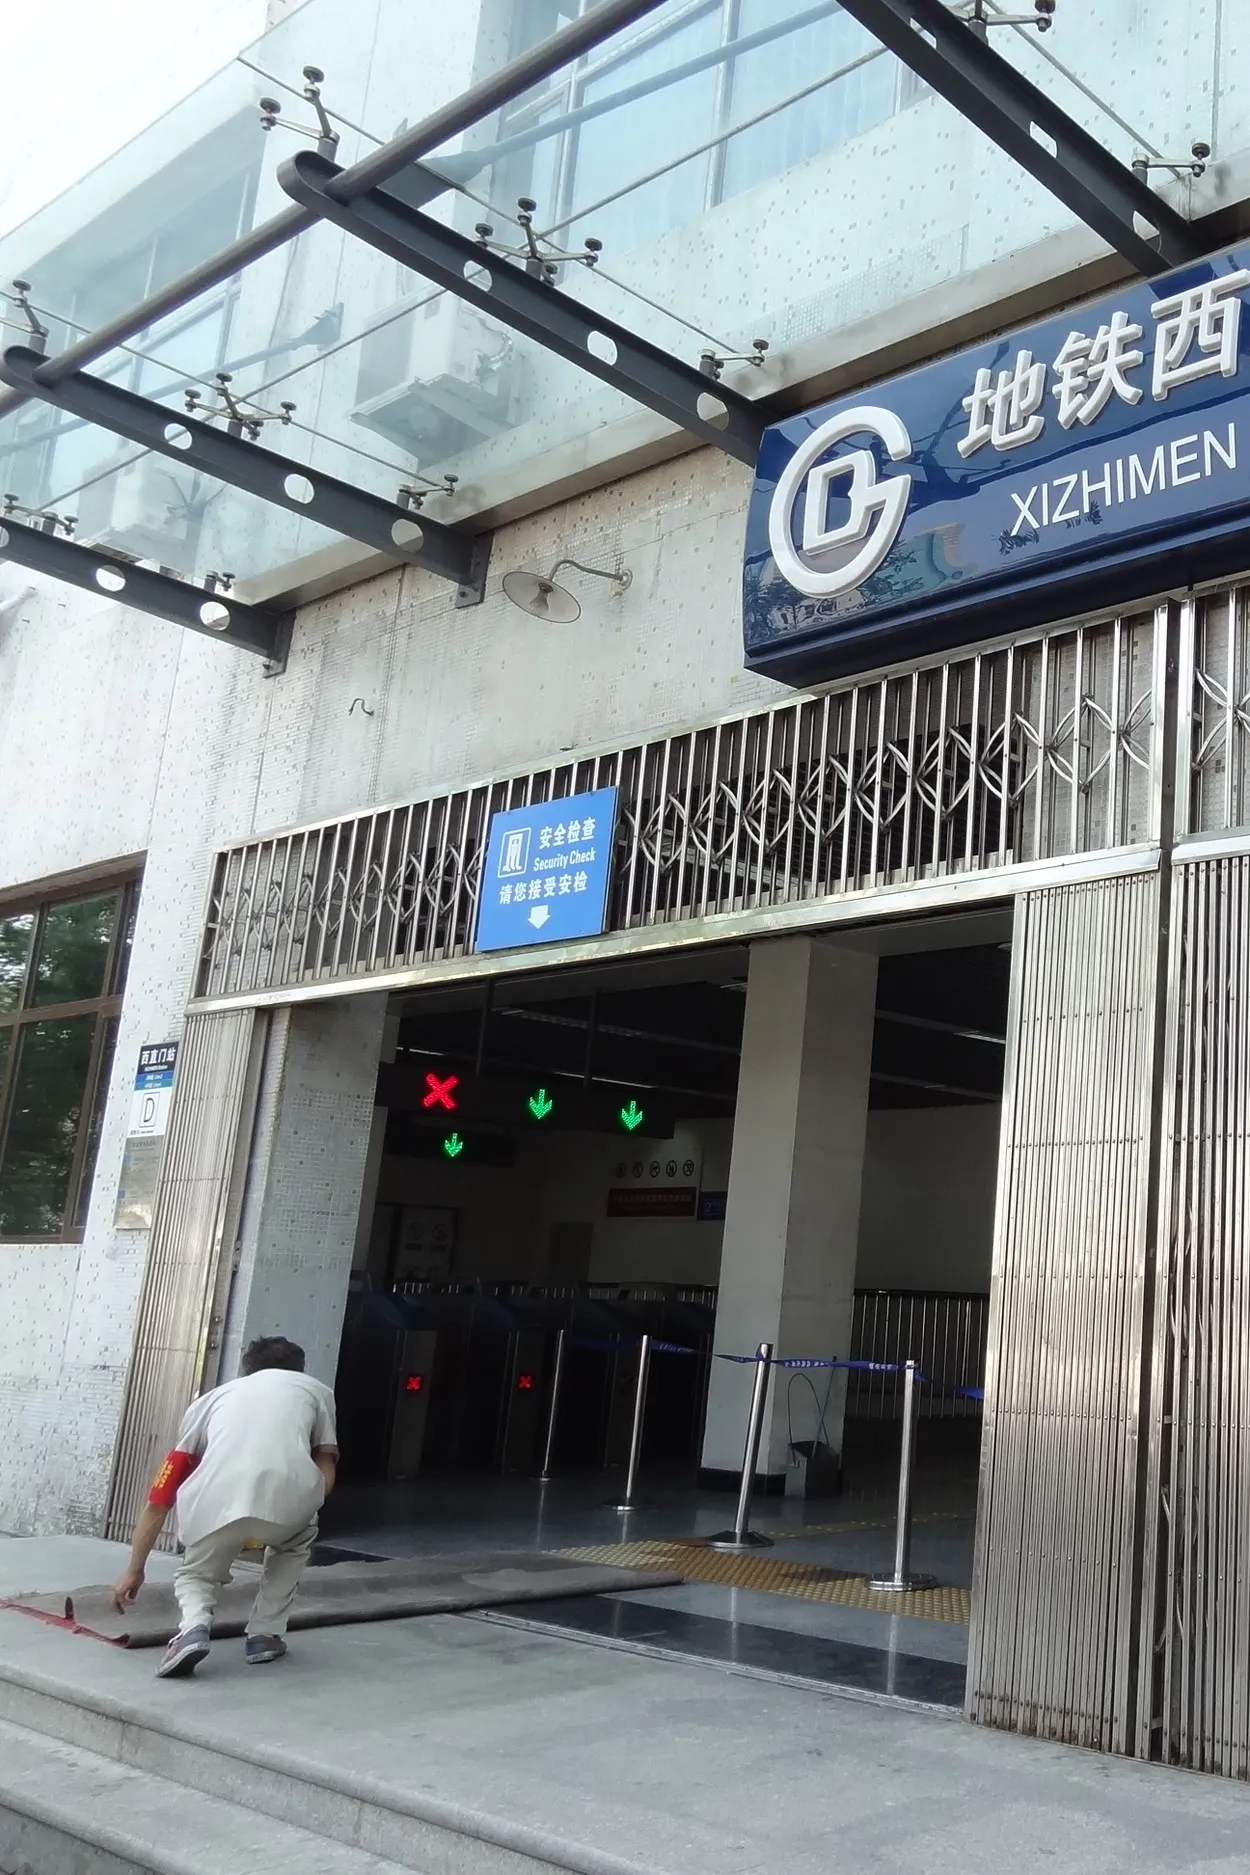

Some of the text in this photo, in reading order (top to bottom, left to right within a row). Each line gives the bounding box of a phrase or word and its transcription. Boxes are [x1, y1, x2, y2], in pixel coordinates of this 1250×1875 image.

[1009, 421, 1238, 537] XIZHIMEN
[539, 817, 596, 850] 安全检查
[533, 848, 595, 872] Security Check
[499, 871, 588, 904] 请您接受安检
[141, 1048, 175, 1065] 西直门站
[144, 1098, 155, 1122] D
